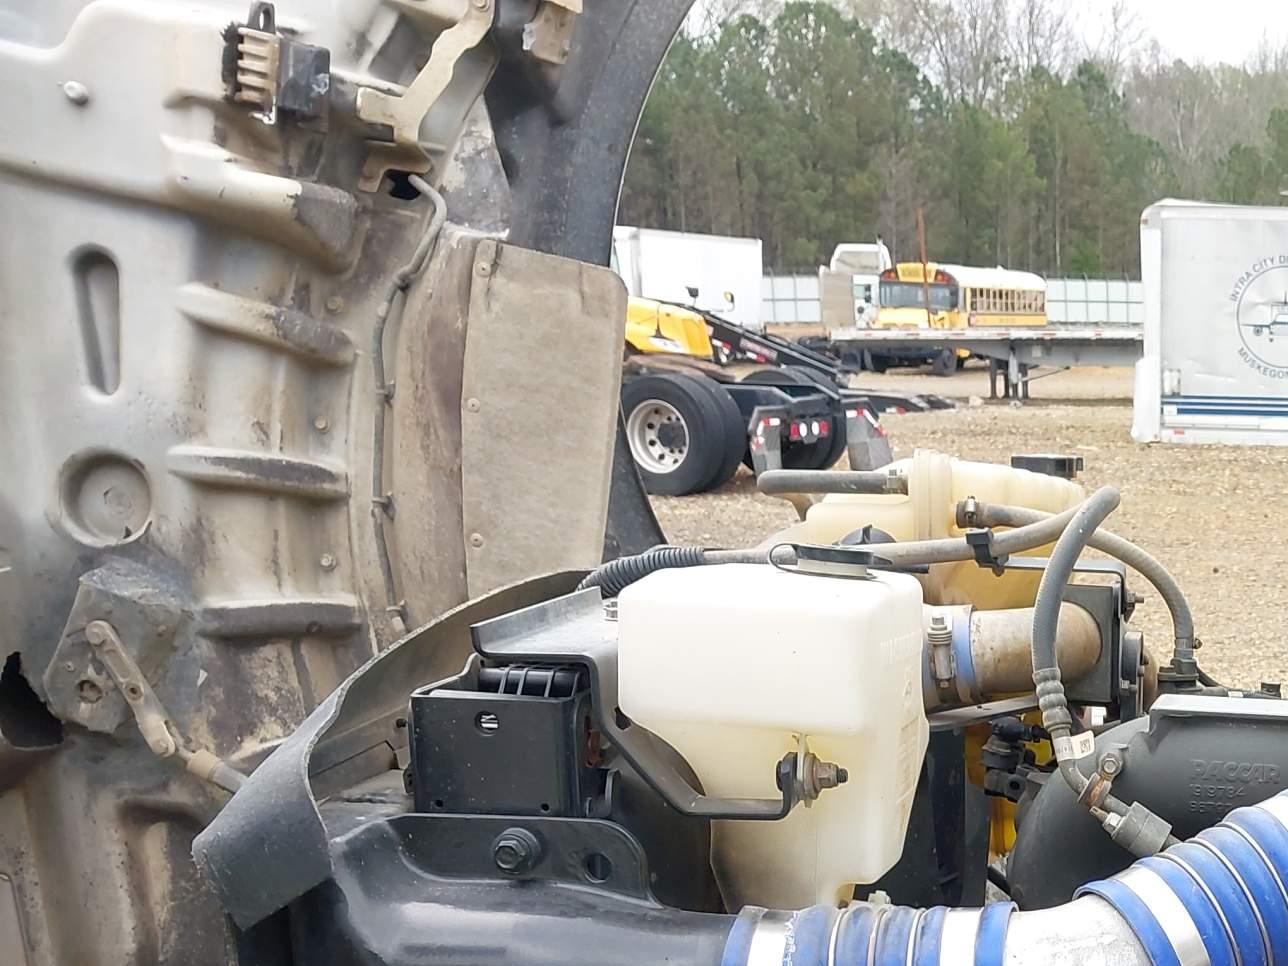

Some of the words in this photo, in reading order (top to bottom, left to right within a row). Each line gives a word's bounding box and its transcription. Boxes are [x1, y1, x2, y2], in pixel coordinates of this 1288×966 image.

[1230, 270, 1253, 302] INTRA
[1252, 255, 1275, 273] CITY
[1189, 759, 1280, 785] PACCAR
